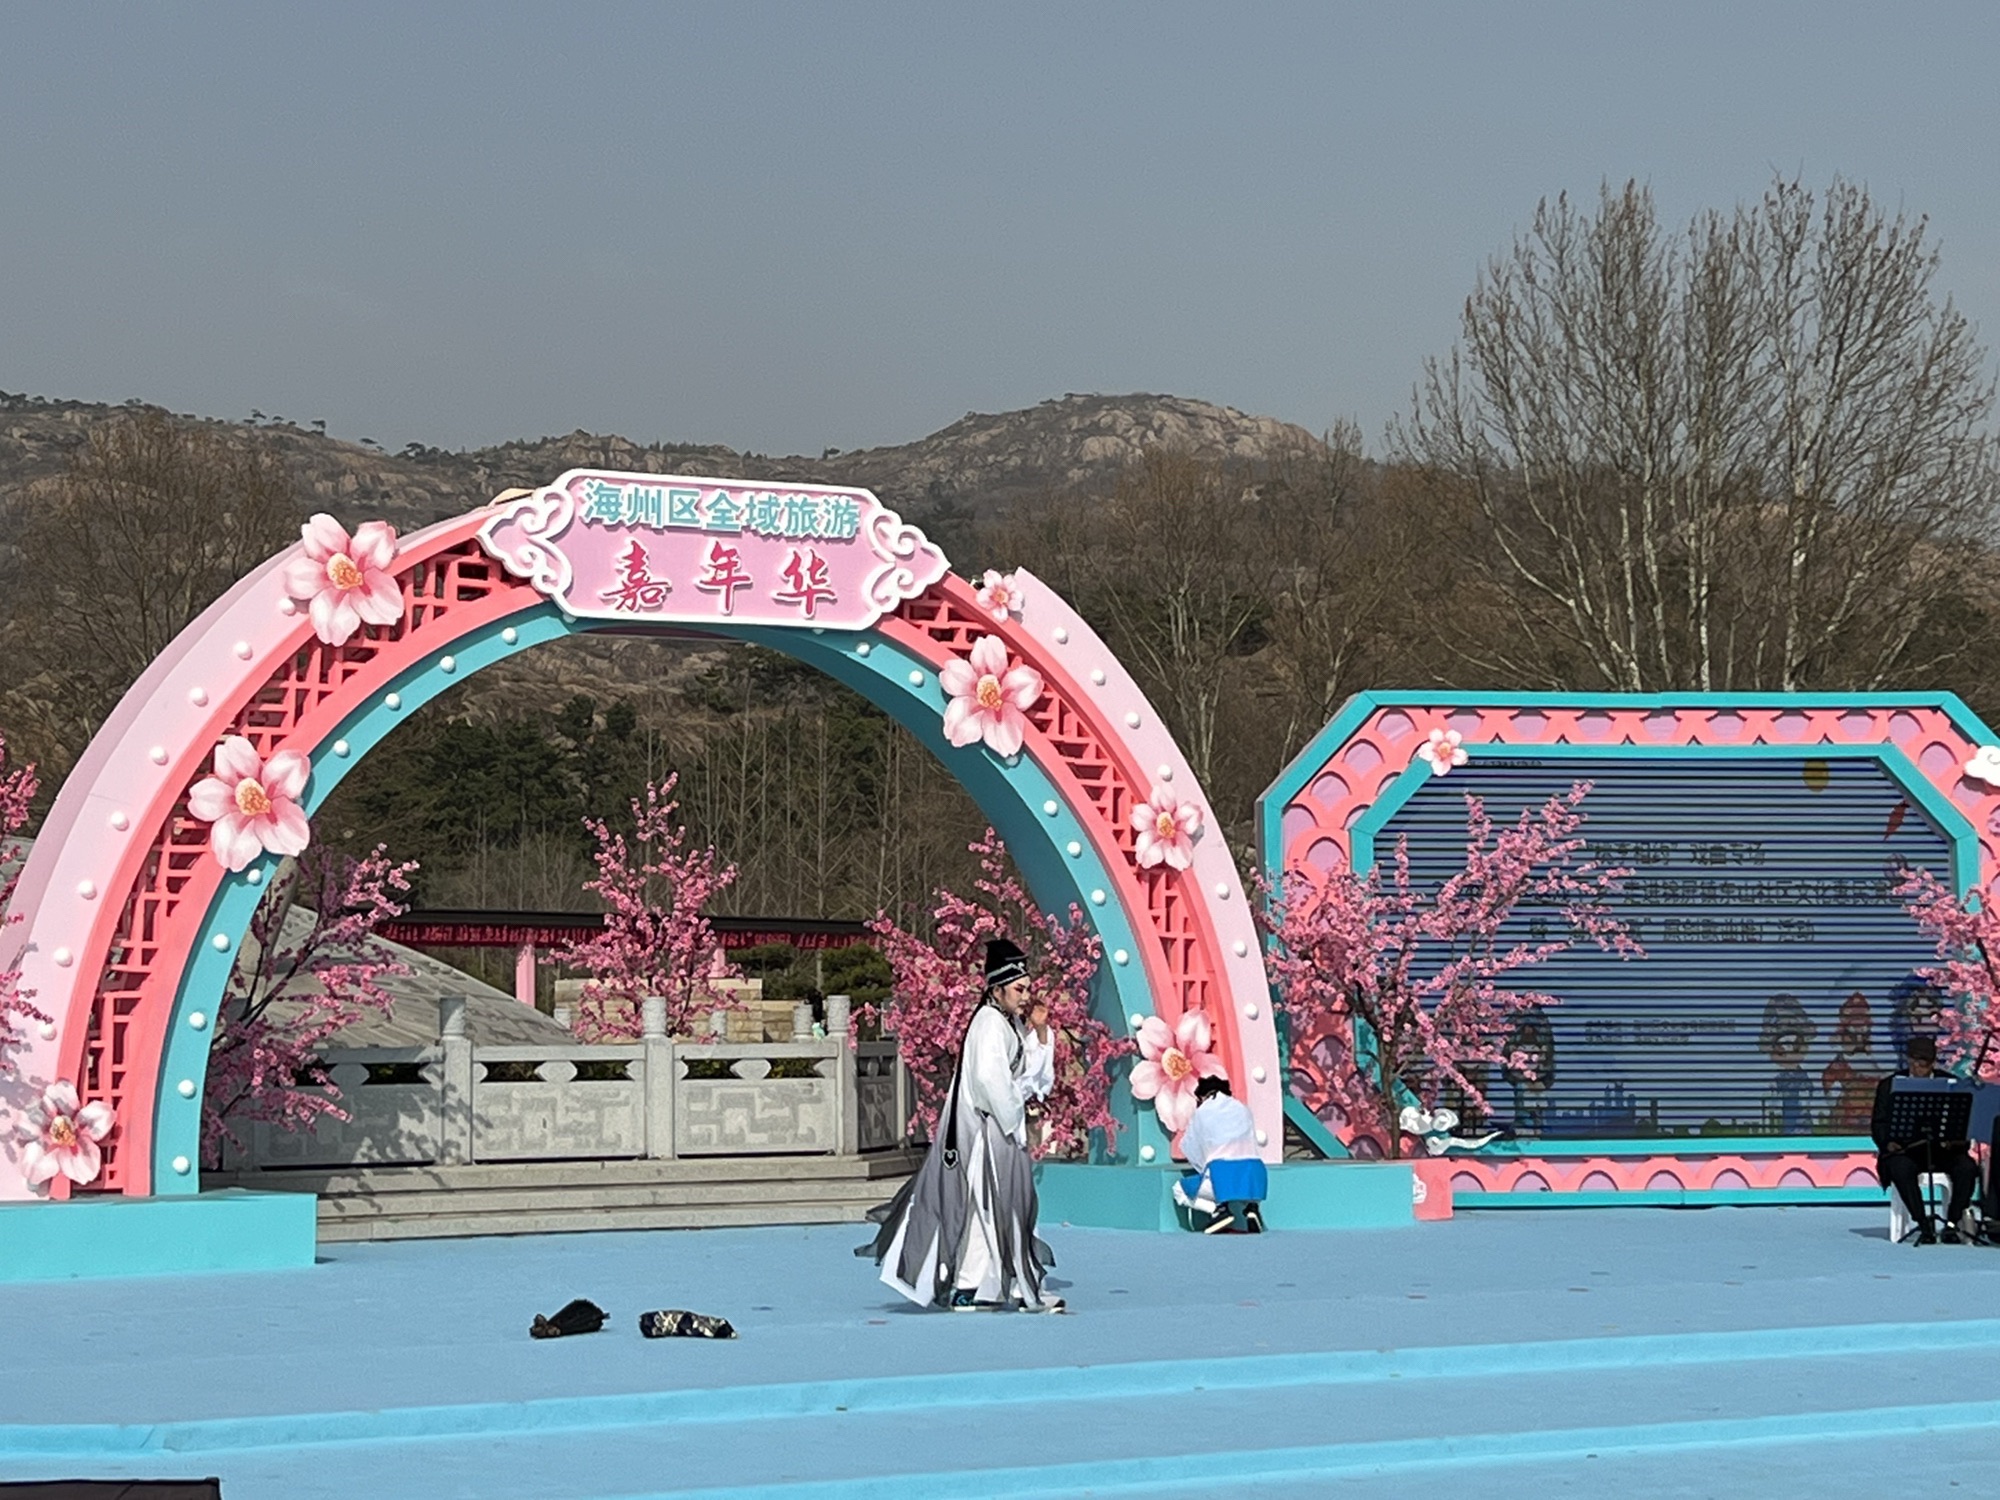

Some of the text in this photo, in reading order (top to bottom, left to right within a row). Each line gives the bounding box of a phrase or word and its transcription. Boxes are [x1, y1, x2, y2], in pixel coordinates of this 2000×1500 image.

[582, 481, 860, 538] 海州区全域旅游
[601, 540, 836, 616] 嘉年华
